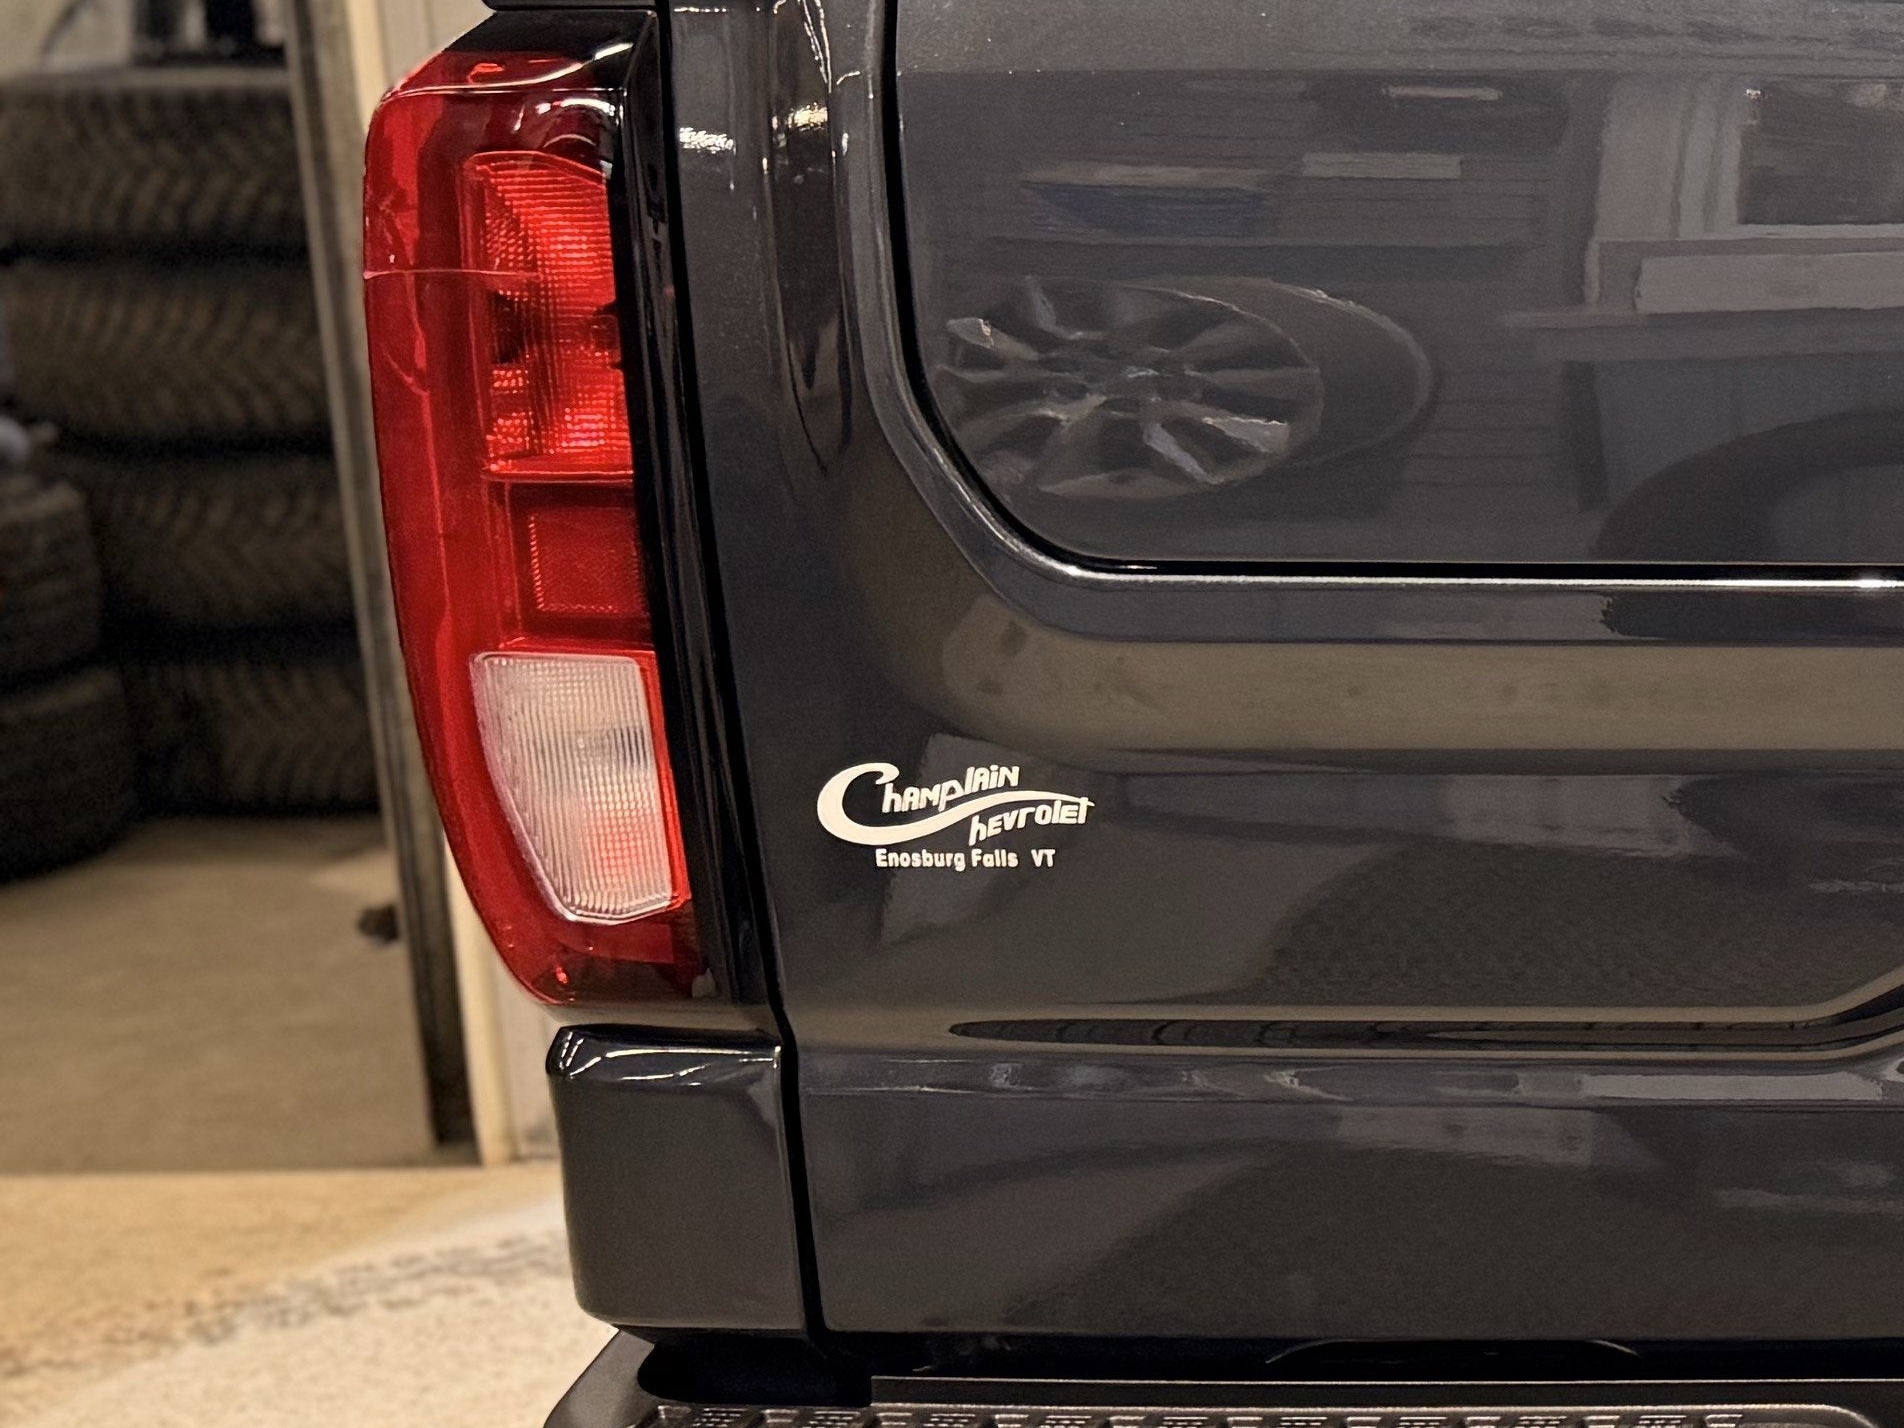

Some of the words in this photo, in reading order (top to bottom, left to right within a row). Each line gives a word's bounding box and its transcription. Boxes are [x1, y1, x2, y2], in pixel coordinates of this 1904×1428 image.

[875, 848, 966, 872] Enosburg
[971, 848, 1019, 868] Falls
[1030, 848, 1056, 868] VT
